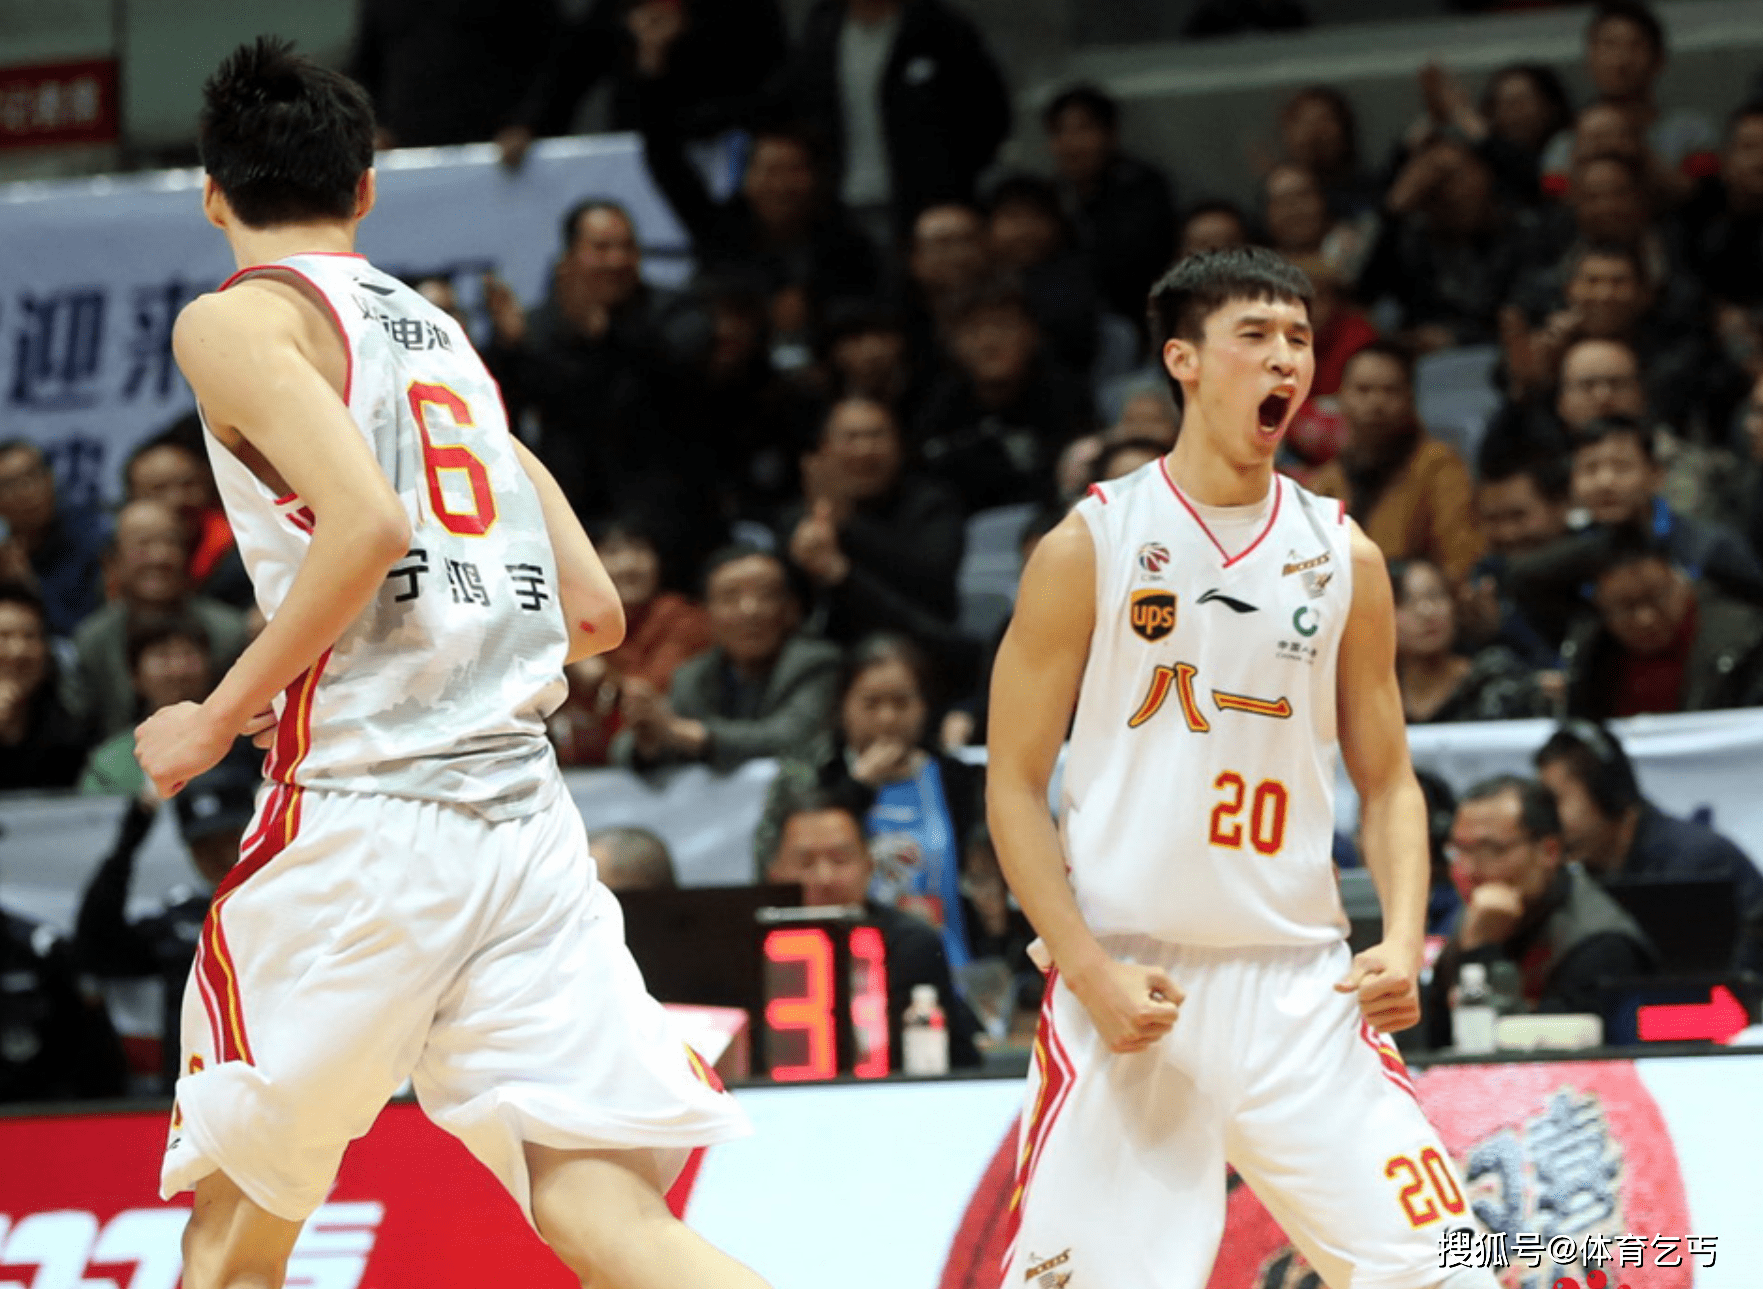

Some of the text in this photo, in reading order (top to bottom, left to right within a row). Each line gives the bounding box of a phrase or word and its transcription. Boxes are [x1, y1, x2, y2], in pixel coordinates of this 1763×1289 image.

[1132, 604, 1174, 635] ups
[1127, 661, 1293, 733] 八一
[1209, 769, 1289, 857] 20
[1384, 1146, 1467, 1231] 20
